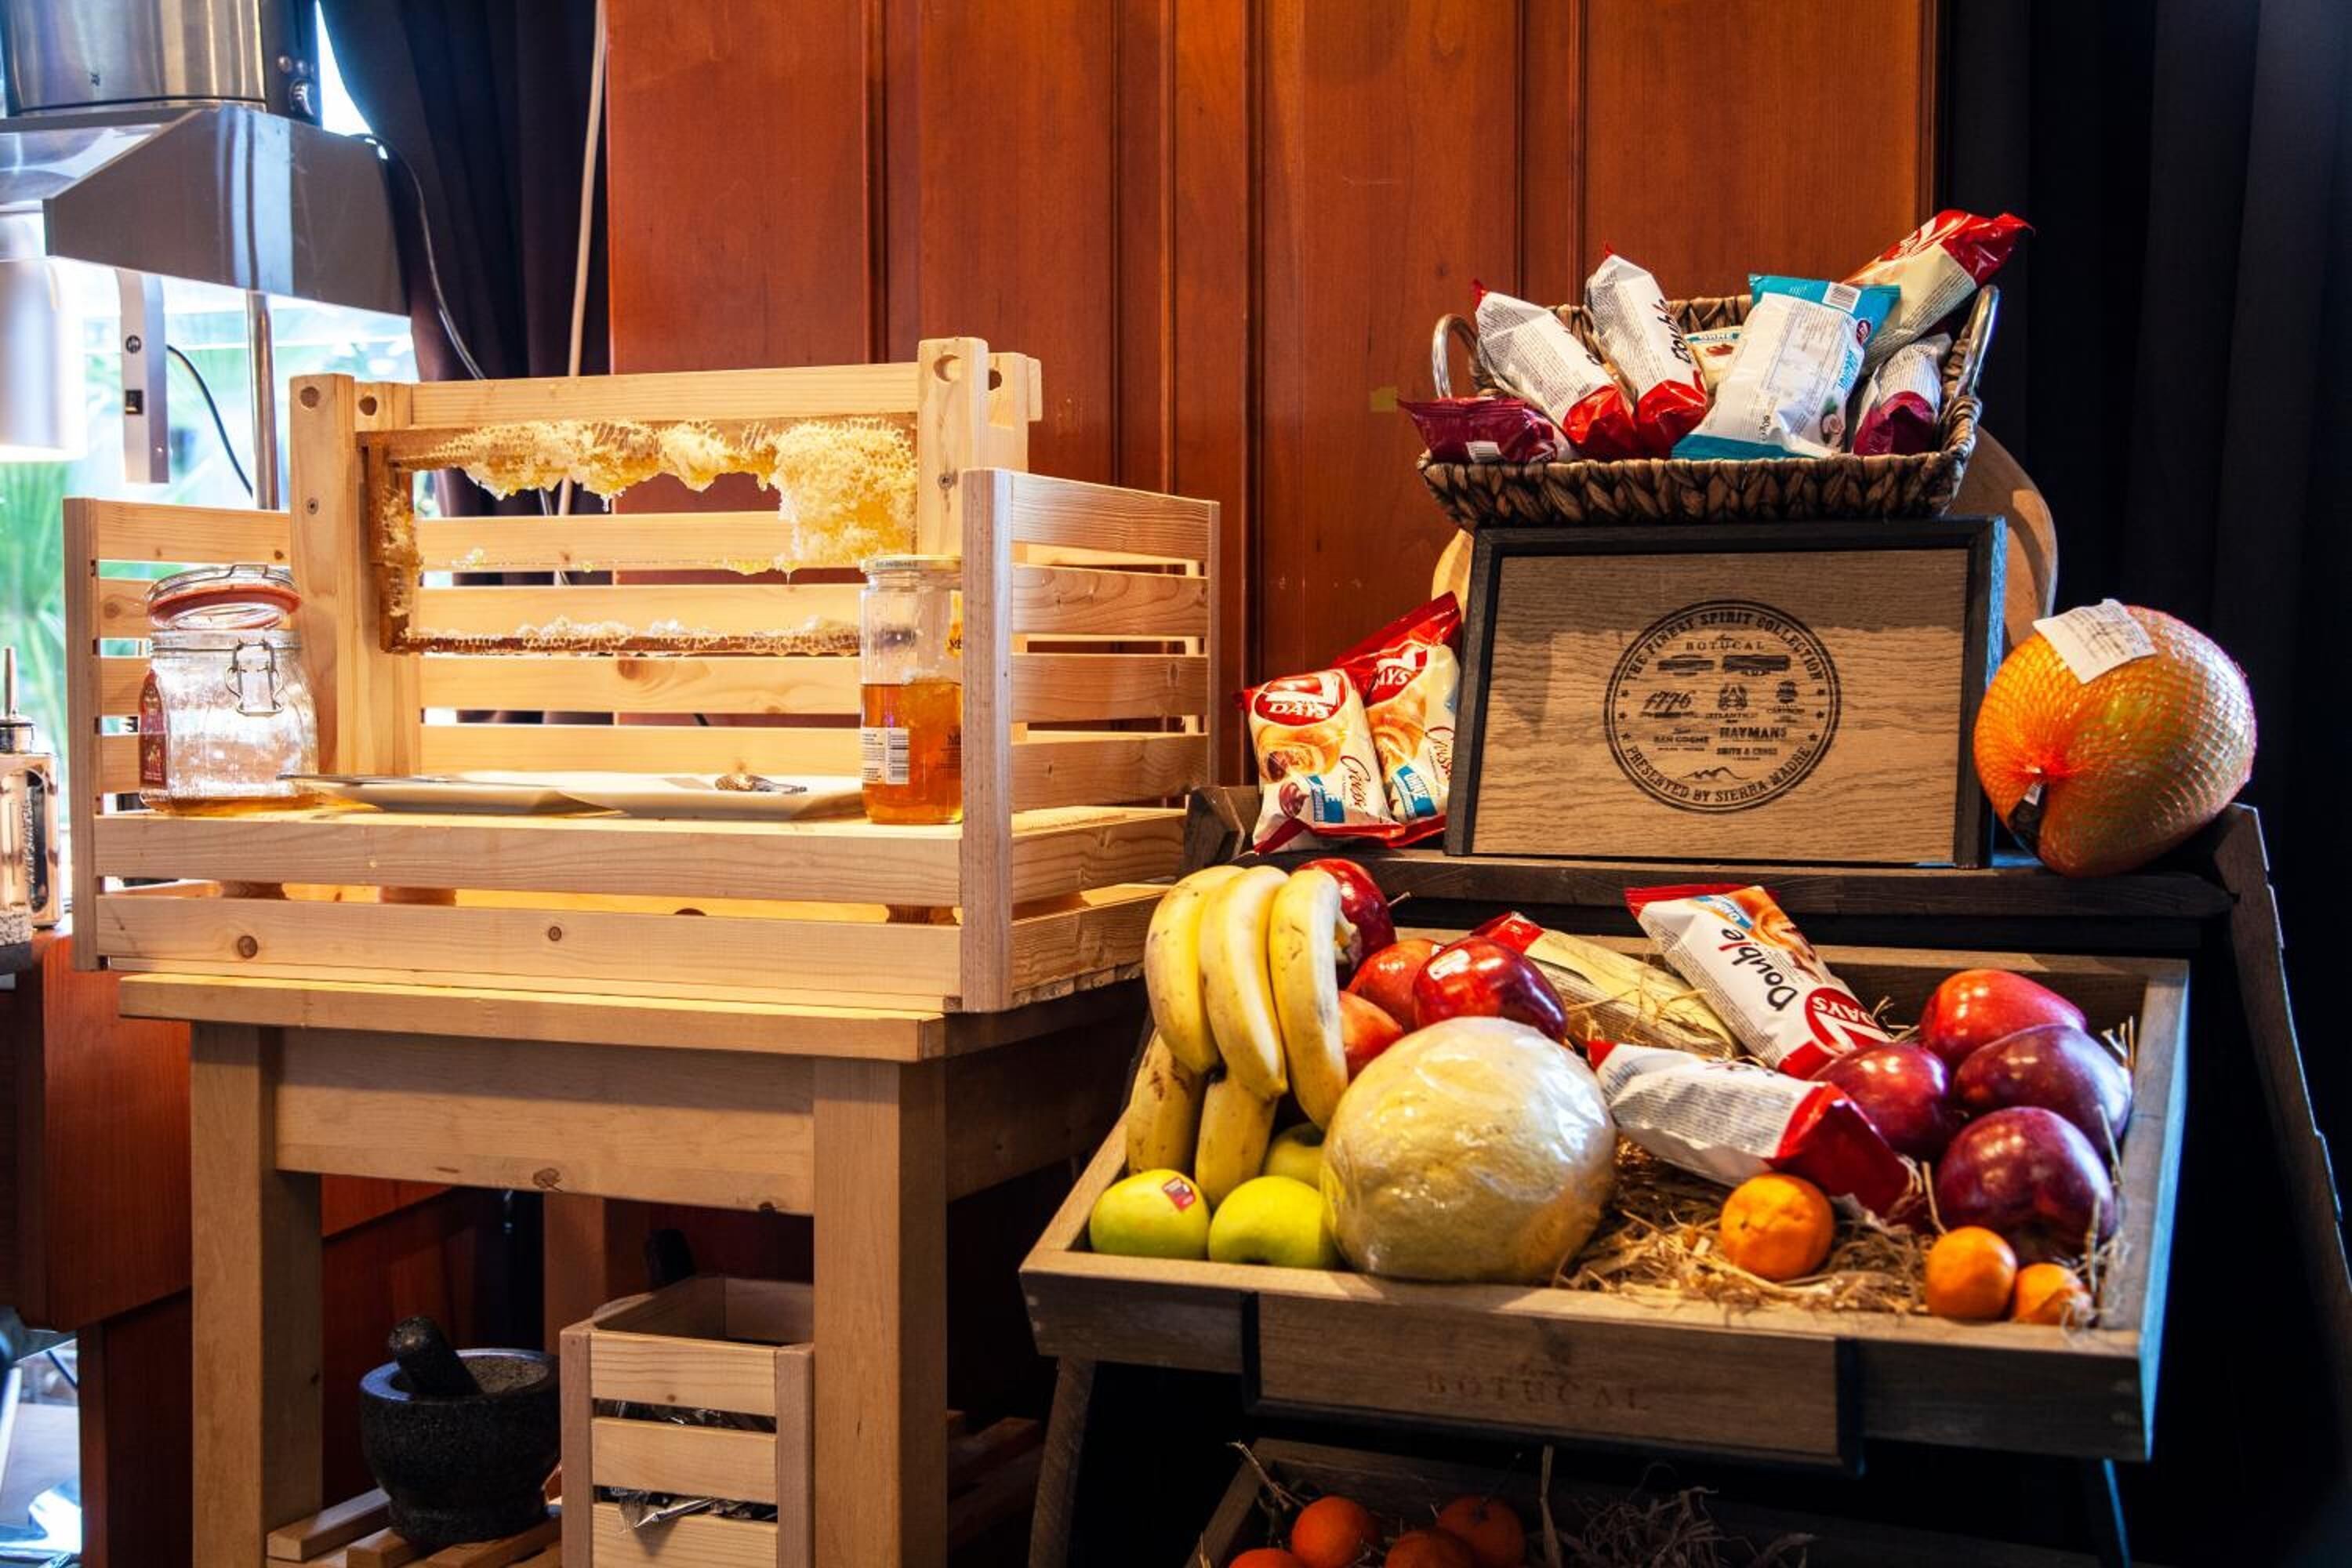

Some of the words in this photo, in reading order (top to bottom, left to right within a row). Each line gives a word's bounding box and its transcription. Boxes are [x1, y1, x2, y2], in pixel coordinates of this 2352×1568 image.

[1624, 653, 1649, 681] THE
[1646, 617, 1694, 655] FINEST
[1700, 612, 1754, 626] SPIRIT
[1756, 615, 1824, 681] COLLECTION
[1267, 701, 1333, 719] DAYS
[1625, 746, 1690, 798] PRESENTED
[1693, 789, 1711, 801] BY
[1715, 780, 1769, 802] SIERRA
[1768, 746, 1811, 786] MADRE
[1719, 927, 1798, 1012] Double
[1428, 1374, 1650, 1410] BOTUCAL
